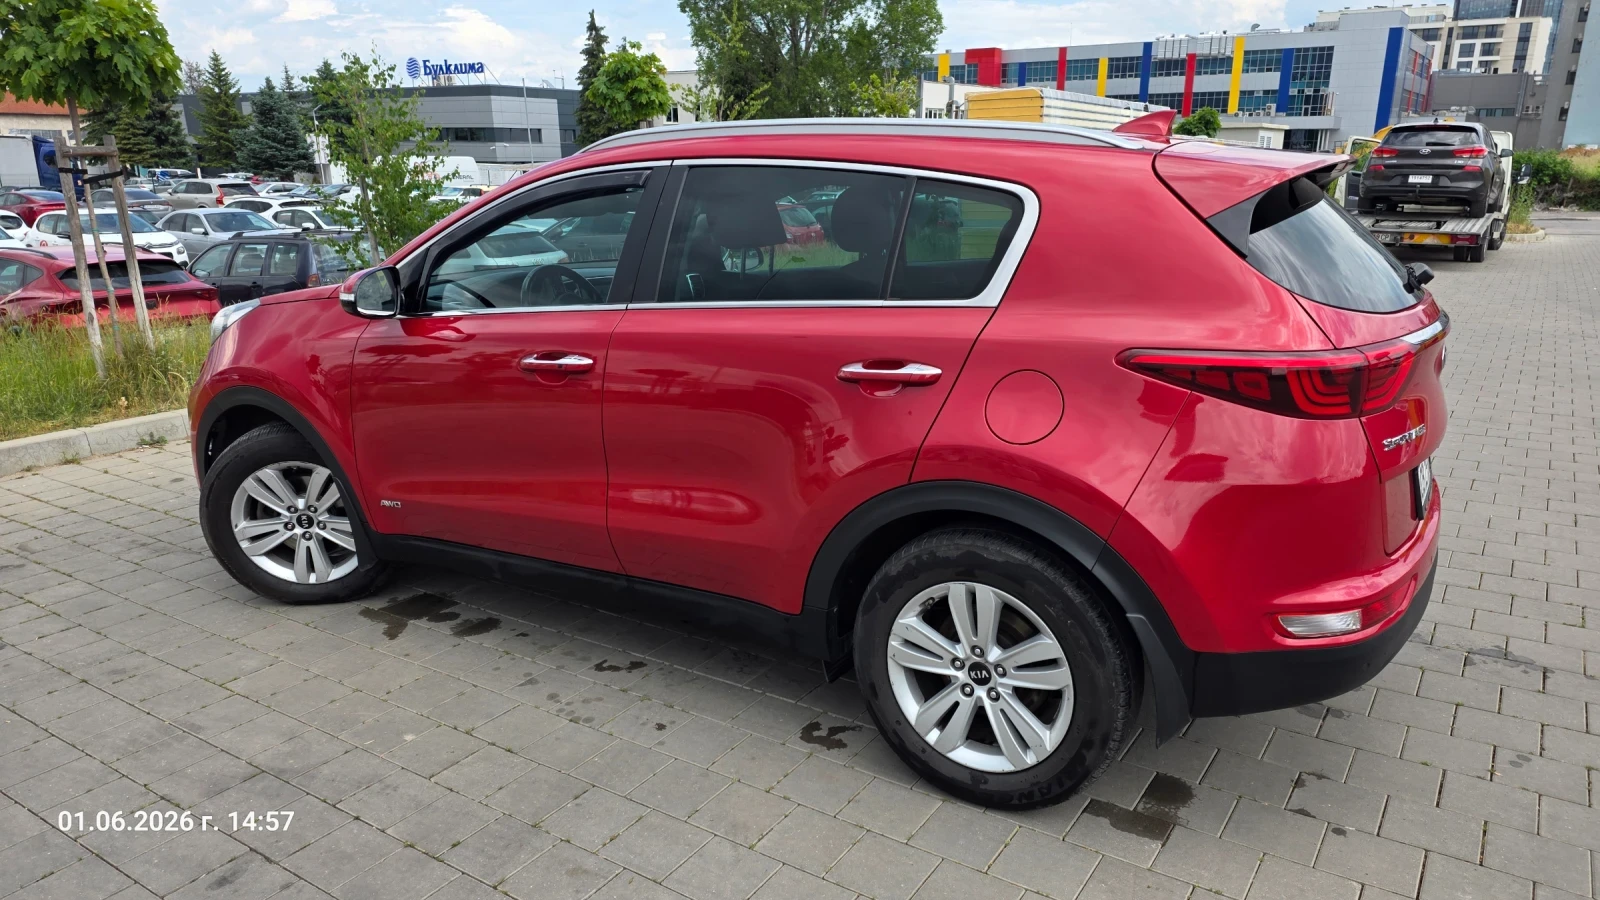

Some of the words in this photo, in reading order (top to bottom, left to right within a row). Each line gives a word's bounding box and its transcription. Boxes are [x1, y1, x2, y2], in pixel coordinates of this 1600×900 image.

[422, 59, 484, 80] Булклима
[380, 499, 401, 508] AWD
[301, 515, 309, 529] KIA
[970, 670, 989, 679] KIA
